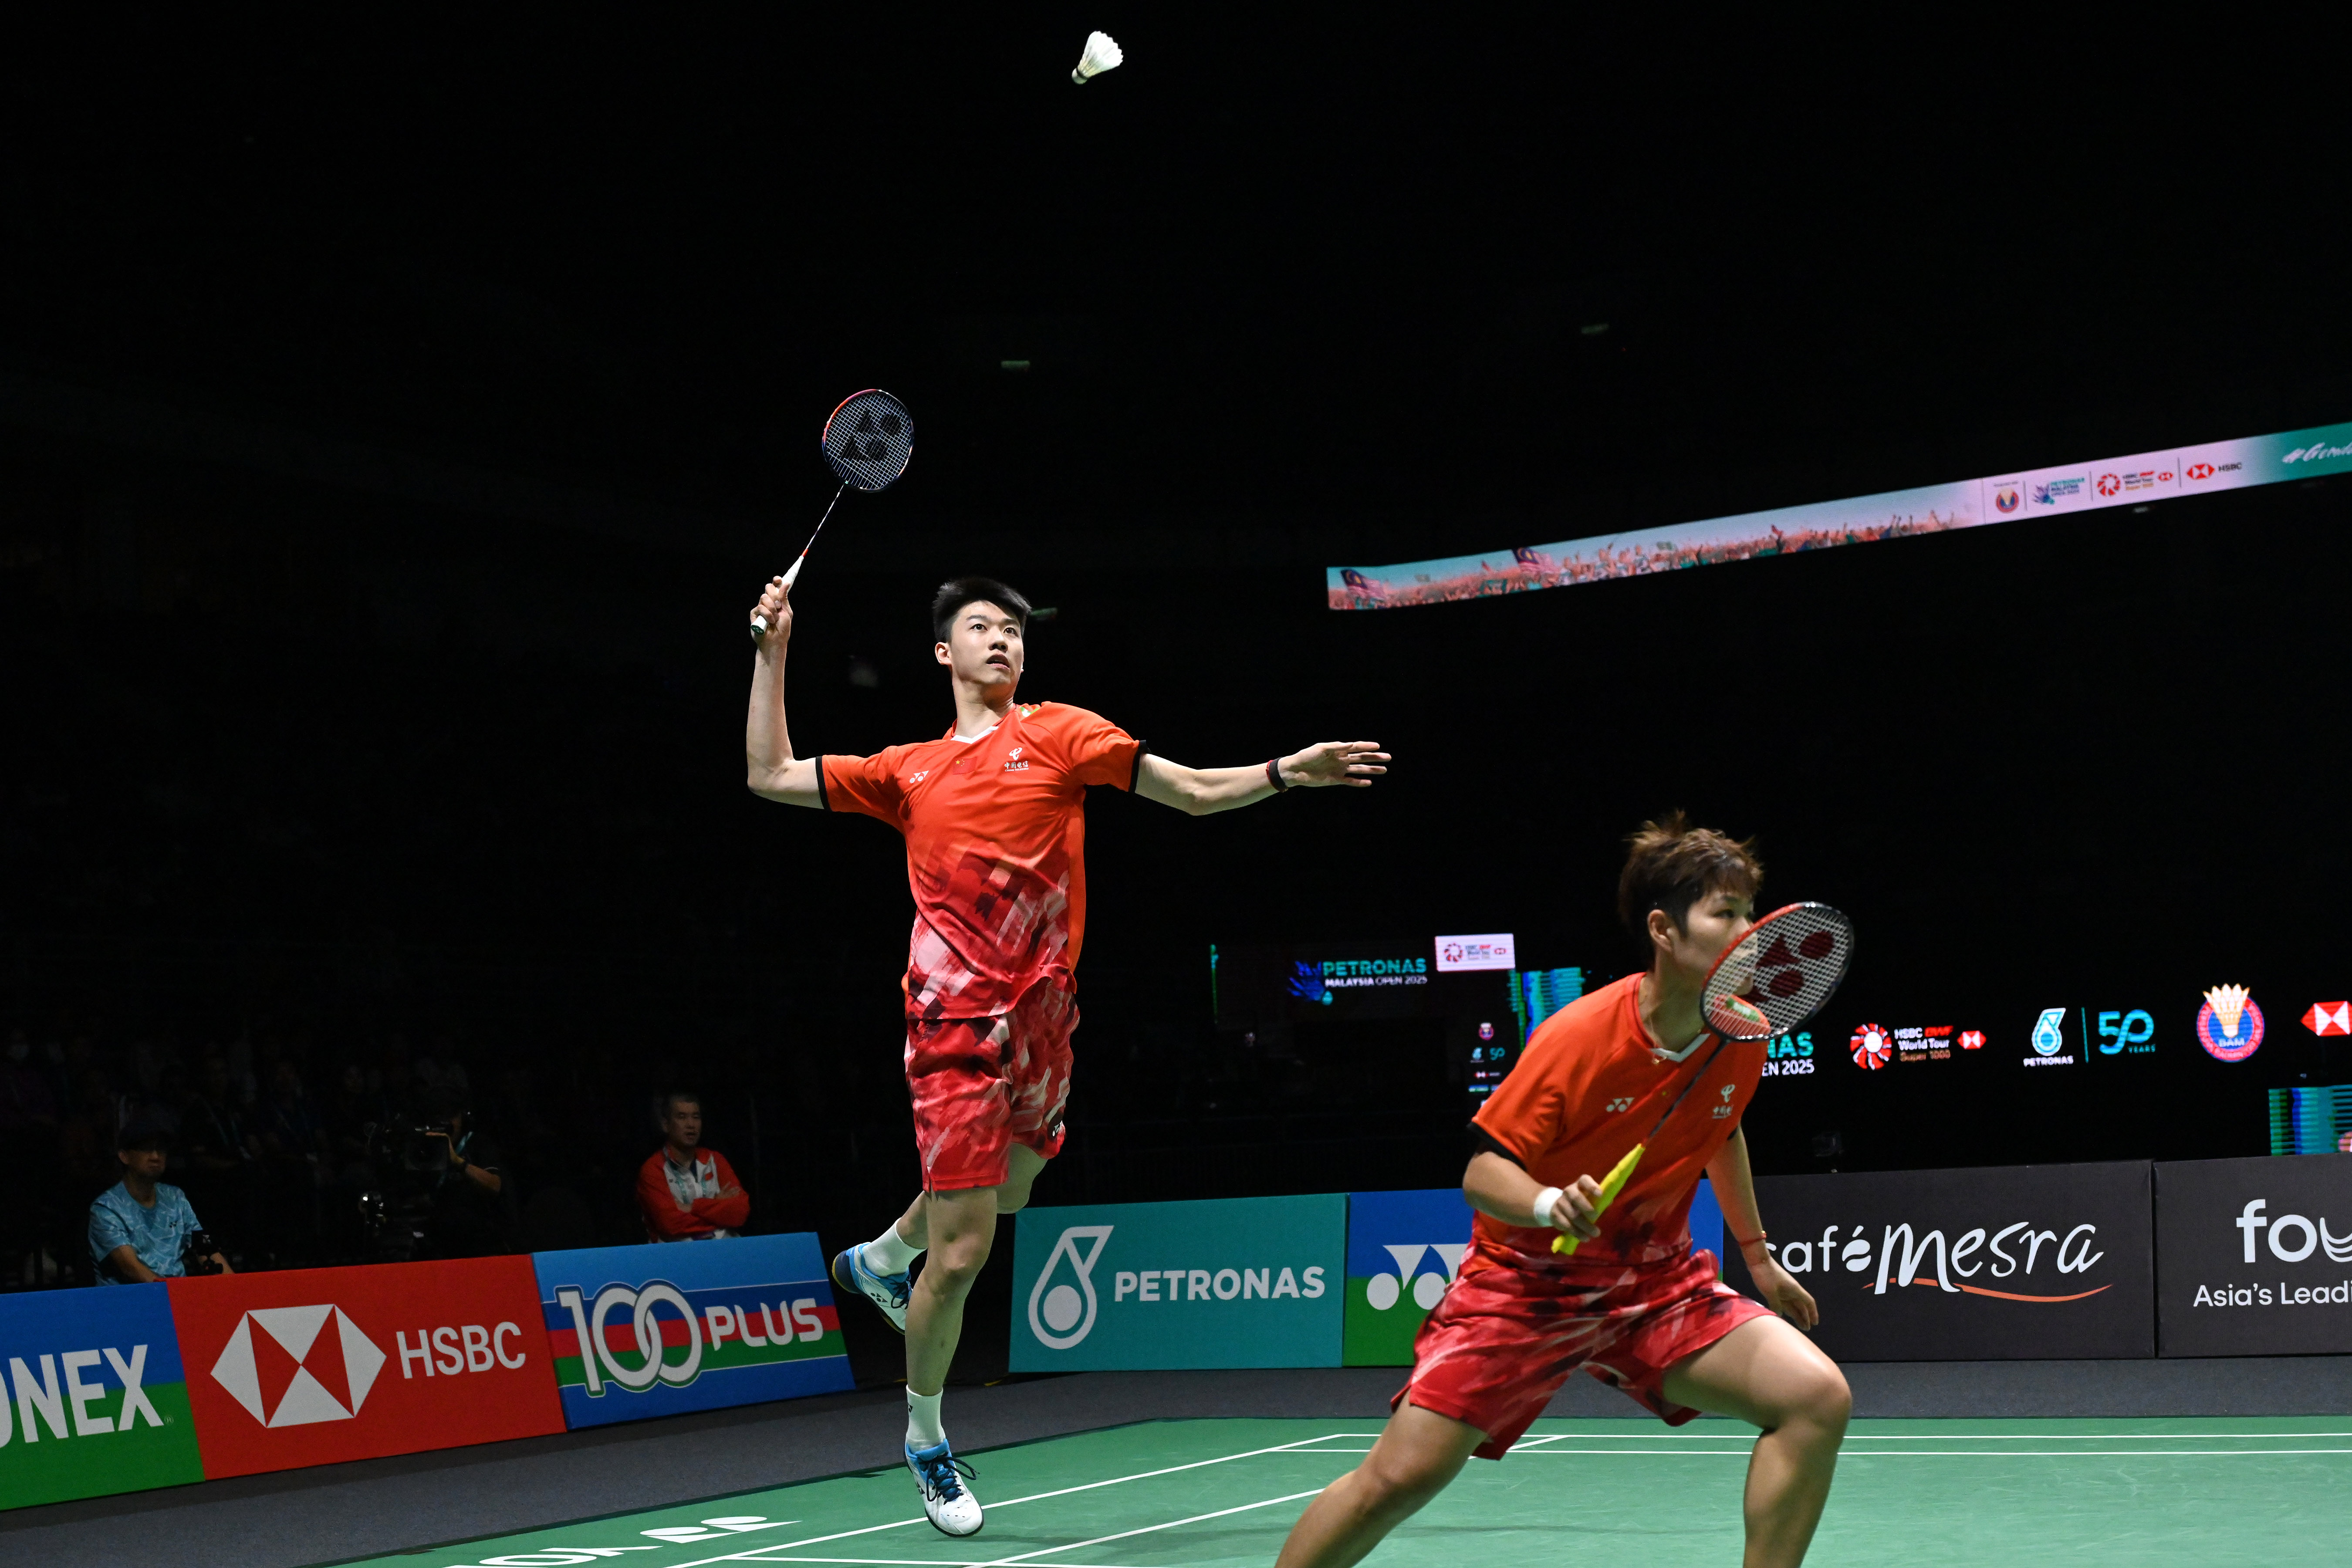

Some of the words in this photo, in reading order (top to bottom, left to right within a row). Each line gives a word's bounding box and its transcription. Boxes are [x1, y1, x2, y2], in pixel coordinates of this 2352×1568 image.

[1004, 760, 1028, 769] 中国电信
[1322, 958, 1427, 976] PETRONAS
[1325, 977, 1375, 987] MALAYSIA
[1375, 976, 1403, 985] OPEN
[2098, 1009, 2154, 1054] 50
[1898, 1038, 1928, 1051] World
[1928, 1038, 1950, 1048] Tour
[2128, 1044, 2156, 1054] YEARS
[1781, 1058, 1815, 1075] 2025
[2023, 1055, 2074, 1067] PETRONAS
[1765, 1225, 1872, 1273] afé
[1115, 1266, 1325, 1302] PETRONAS
[2193, 1283, 2272, 1307] Asia's
[395, 1321, 526, 1379] HSBC
